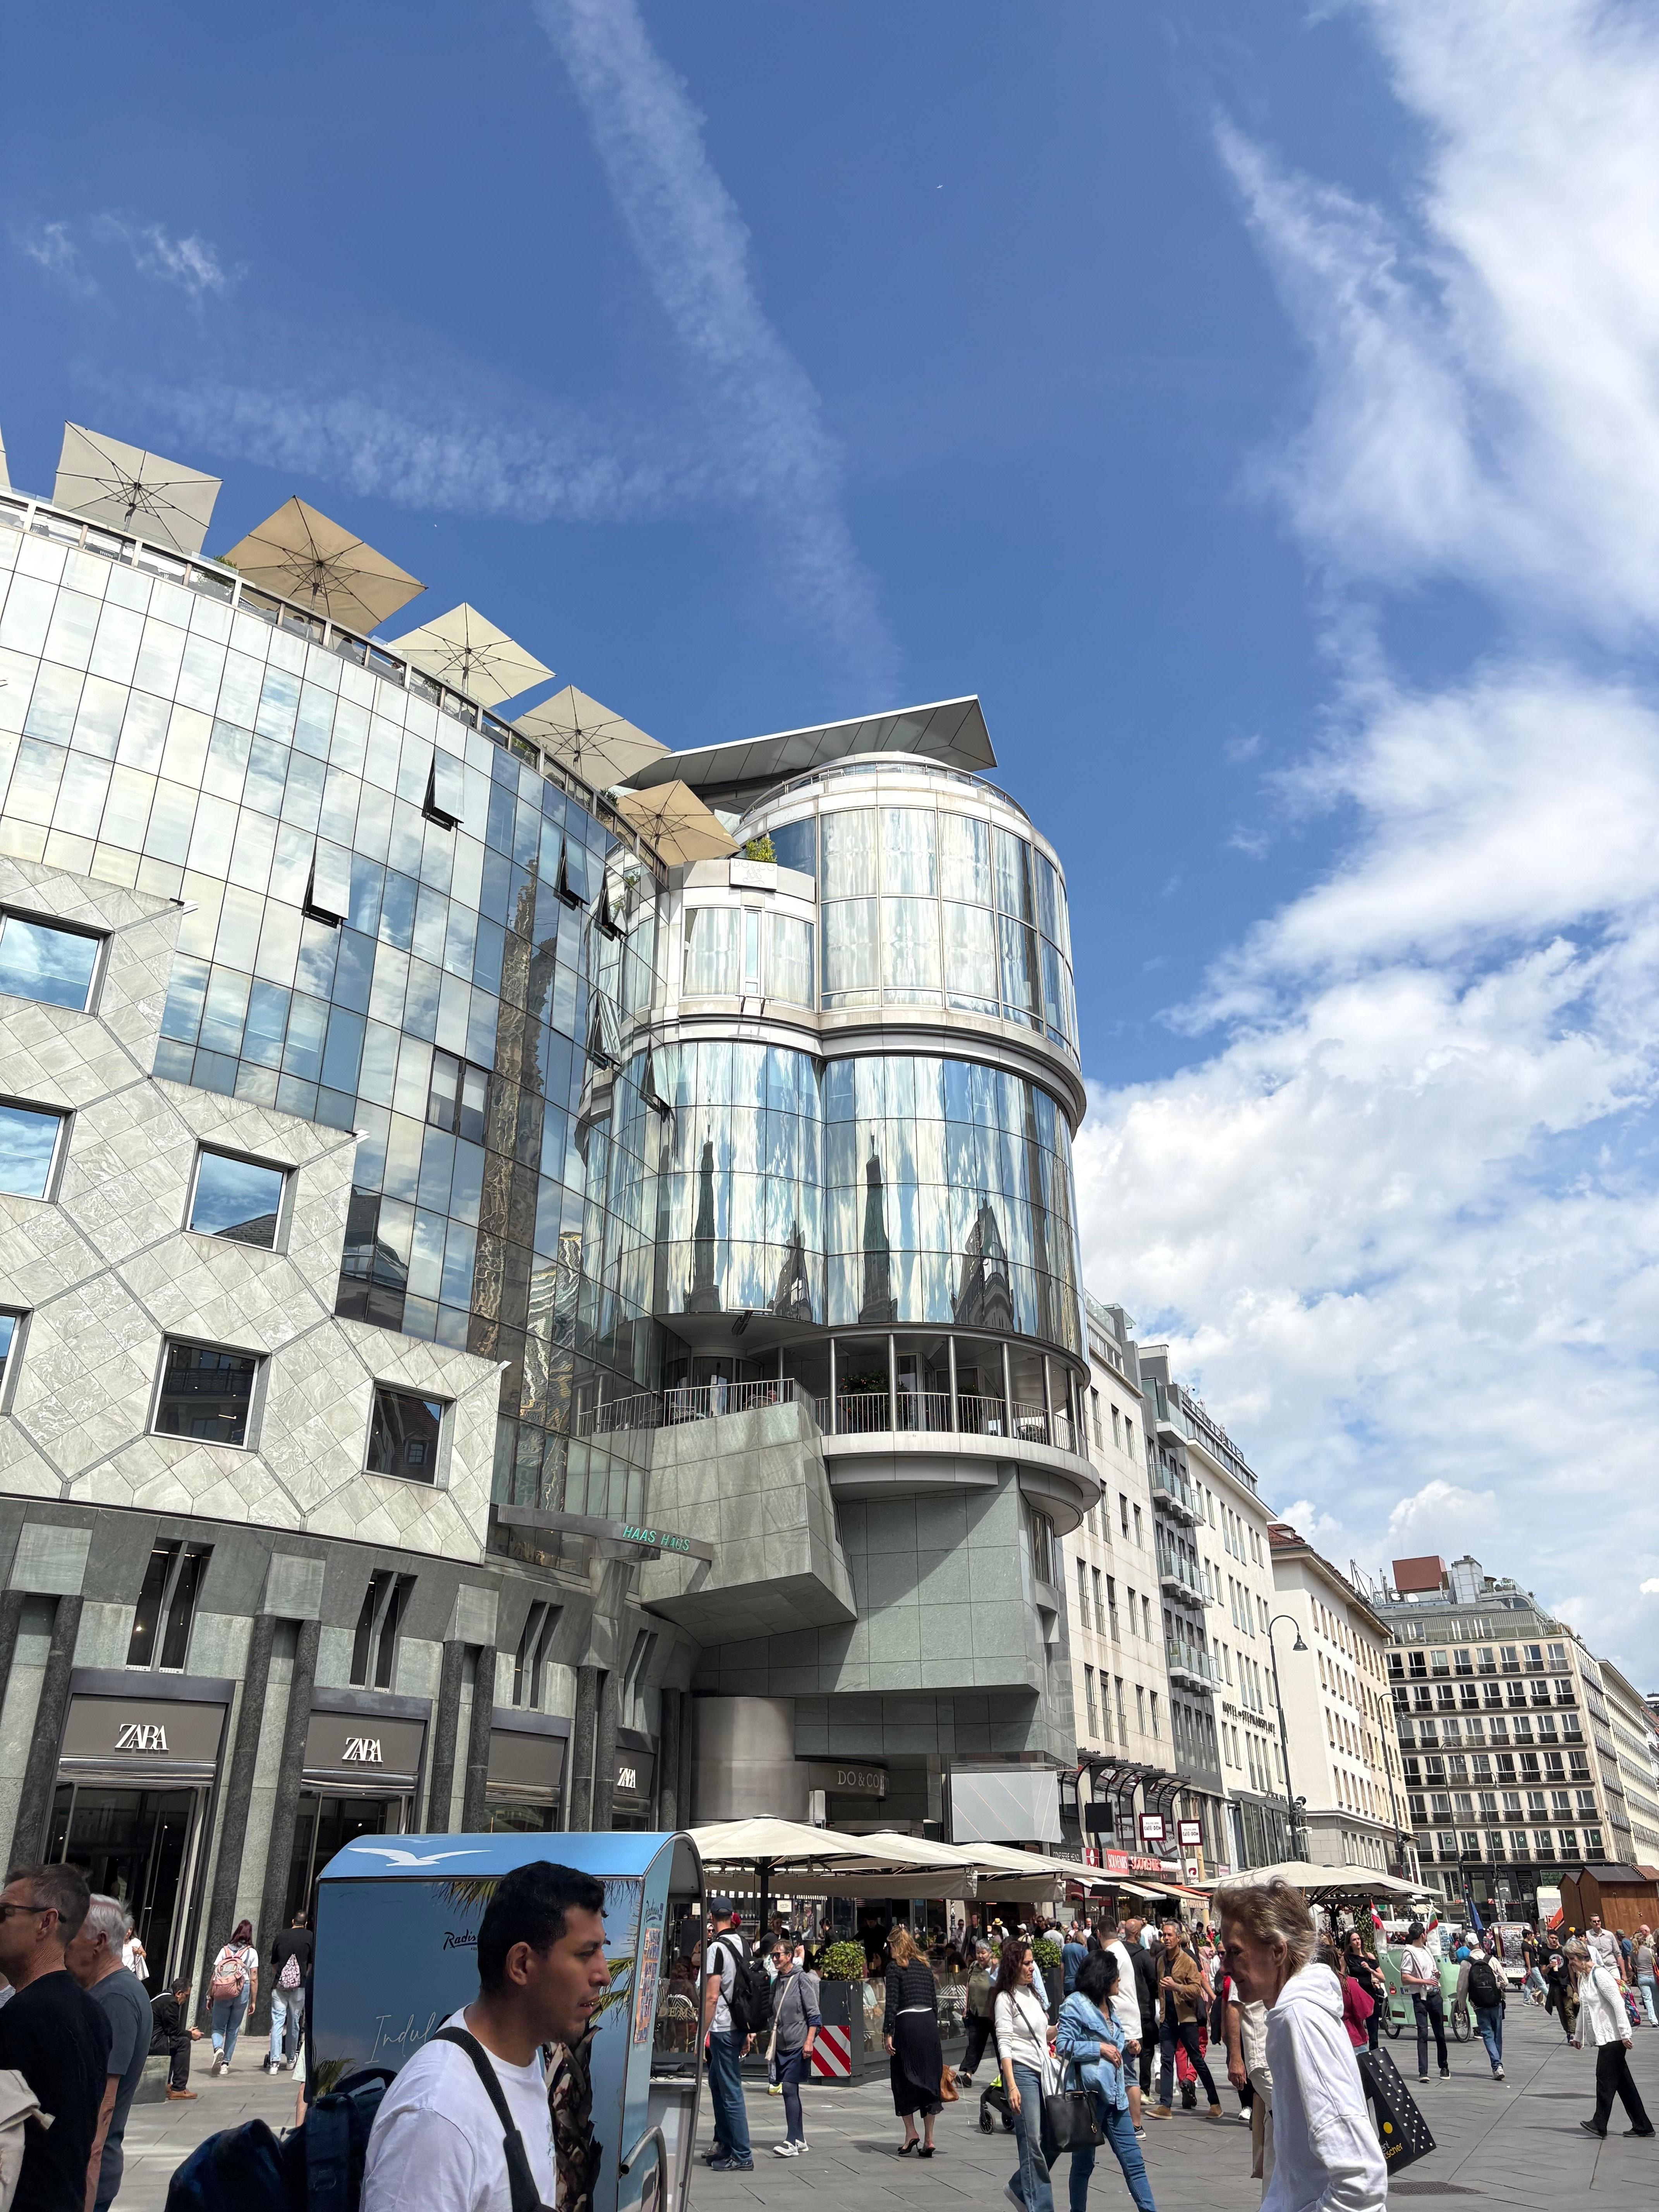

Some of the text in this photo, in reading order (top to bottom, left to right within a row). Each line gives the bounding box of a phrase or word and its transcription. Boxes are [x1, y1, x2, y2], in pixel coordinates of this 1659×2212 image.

[622, 1526, 690, 1551] HAAS HAUS
[1223, 1701, 1238, 1717] HOTEL
[115, 1724, 169, 1750] ZARA
[342, 1738, 383, 1762] ZARA
[617, 1768, 636, 1788] ZARA
[838, 1771, 856, 1785] DO
[858, 1772, 865, 1786] &
[867, 1773, 879, 1788] CO
[1108, 1854, 1127, 1869] SOUVENIRS
[443, 1929, 476, 1951] Radis
[365, 2012, 435, 2063] Indul
